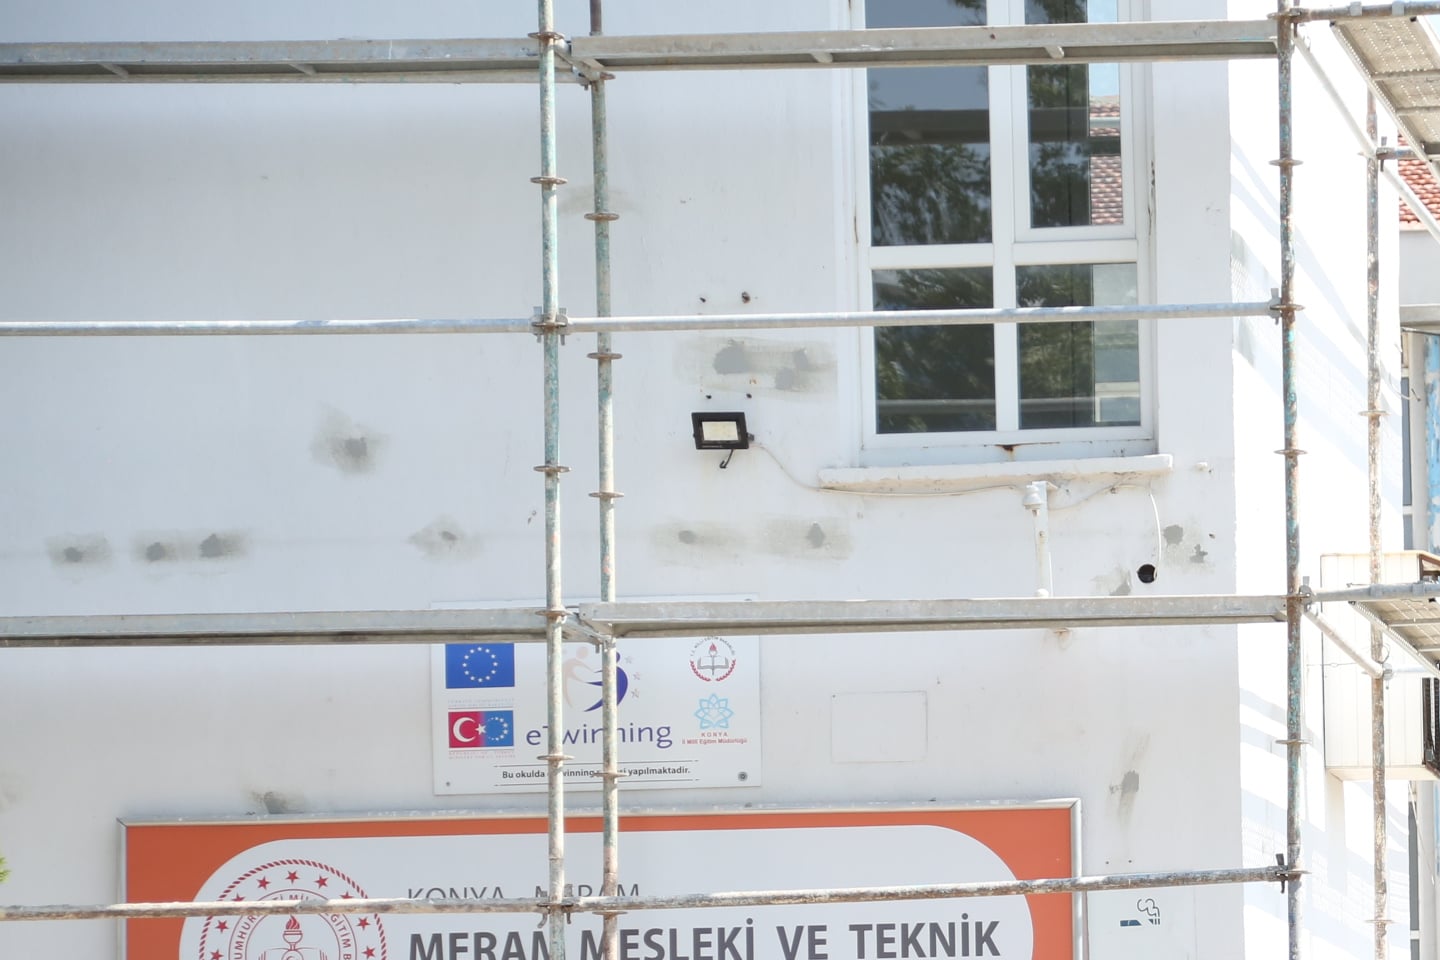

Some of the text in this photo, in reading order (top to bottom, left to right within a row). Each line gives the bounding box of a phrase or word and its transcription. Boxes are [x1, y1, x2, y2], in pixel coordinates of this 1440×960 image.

[526, 722, 673, 749] ewinning
[502, 771, 514, 779] Bu
[515, 770, 546, 779] okulda
[775, 924, 829, 960] VE
[849, 912, 1001, 960] TEKNİK
